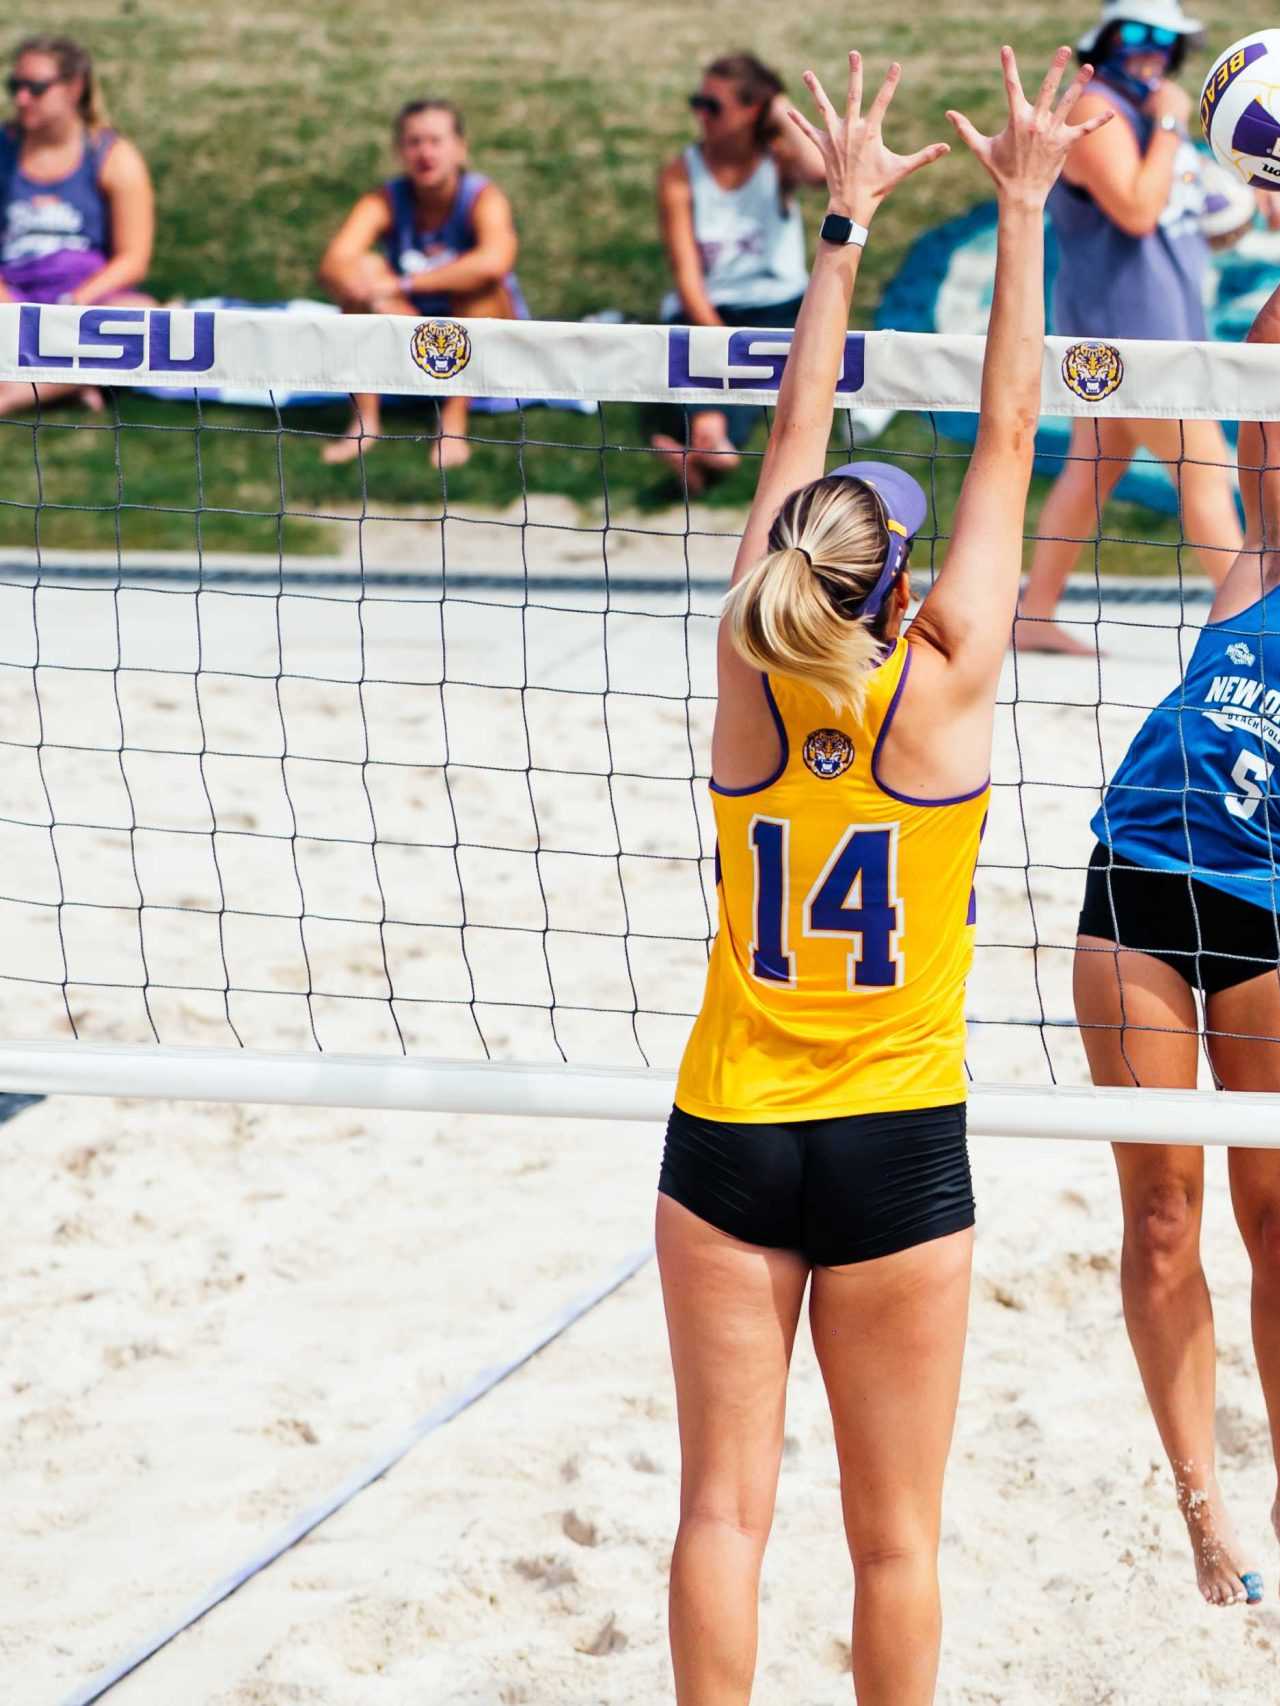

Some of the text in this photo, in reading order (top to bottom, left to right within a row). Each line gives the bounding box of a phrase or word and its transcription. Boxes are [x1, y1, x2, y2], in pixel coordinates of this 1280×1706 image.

[1200, 48, 1245, 133] BEAC
[18, 305, 215, 372] LSU
[1204, 675, 1266, 709] NEW
[1226, 712, 1260, 730] BEACH
[1223, 748, 1275, 821] 5
[748, 813, 905, 993] 14
